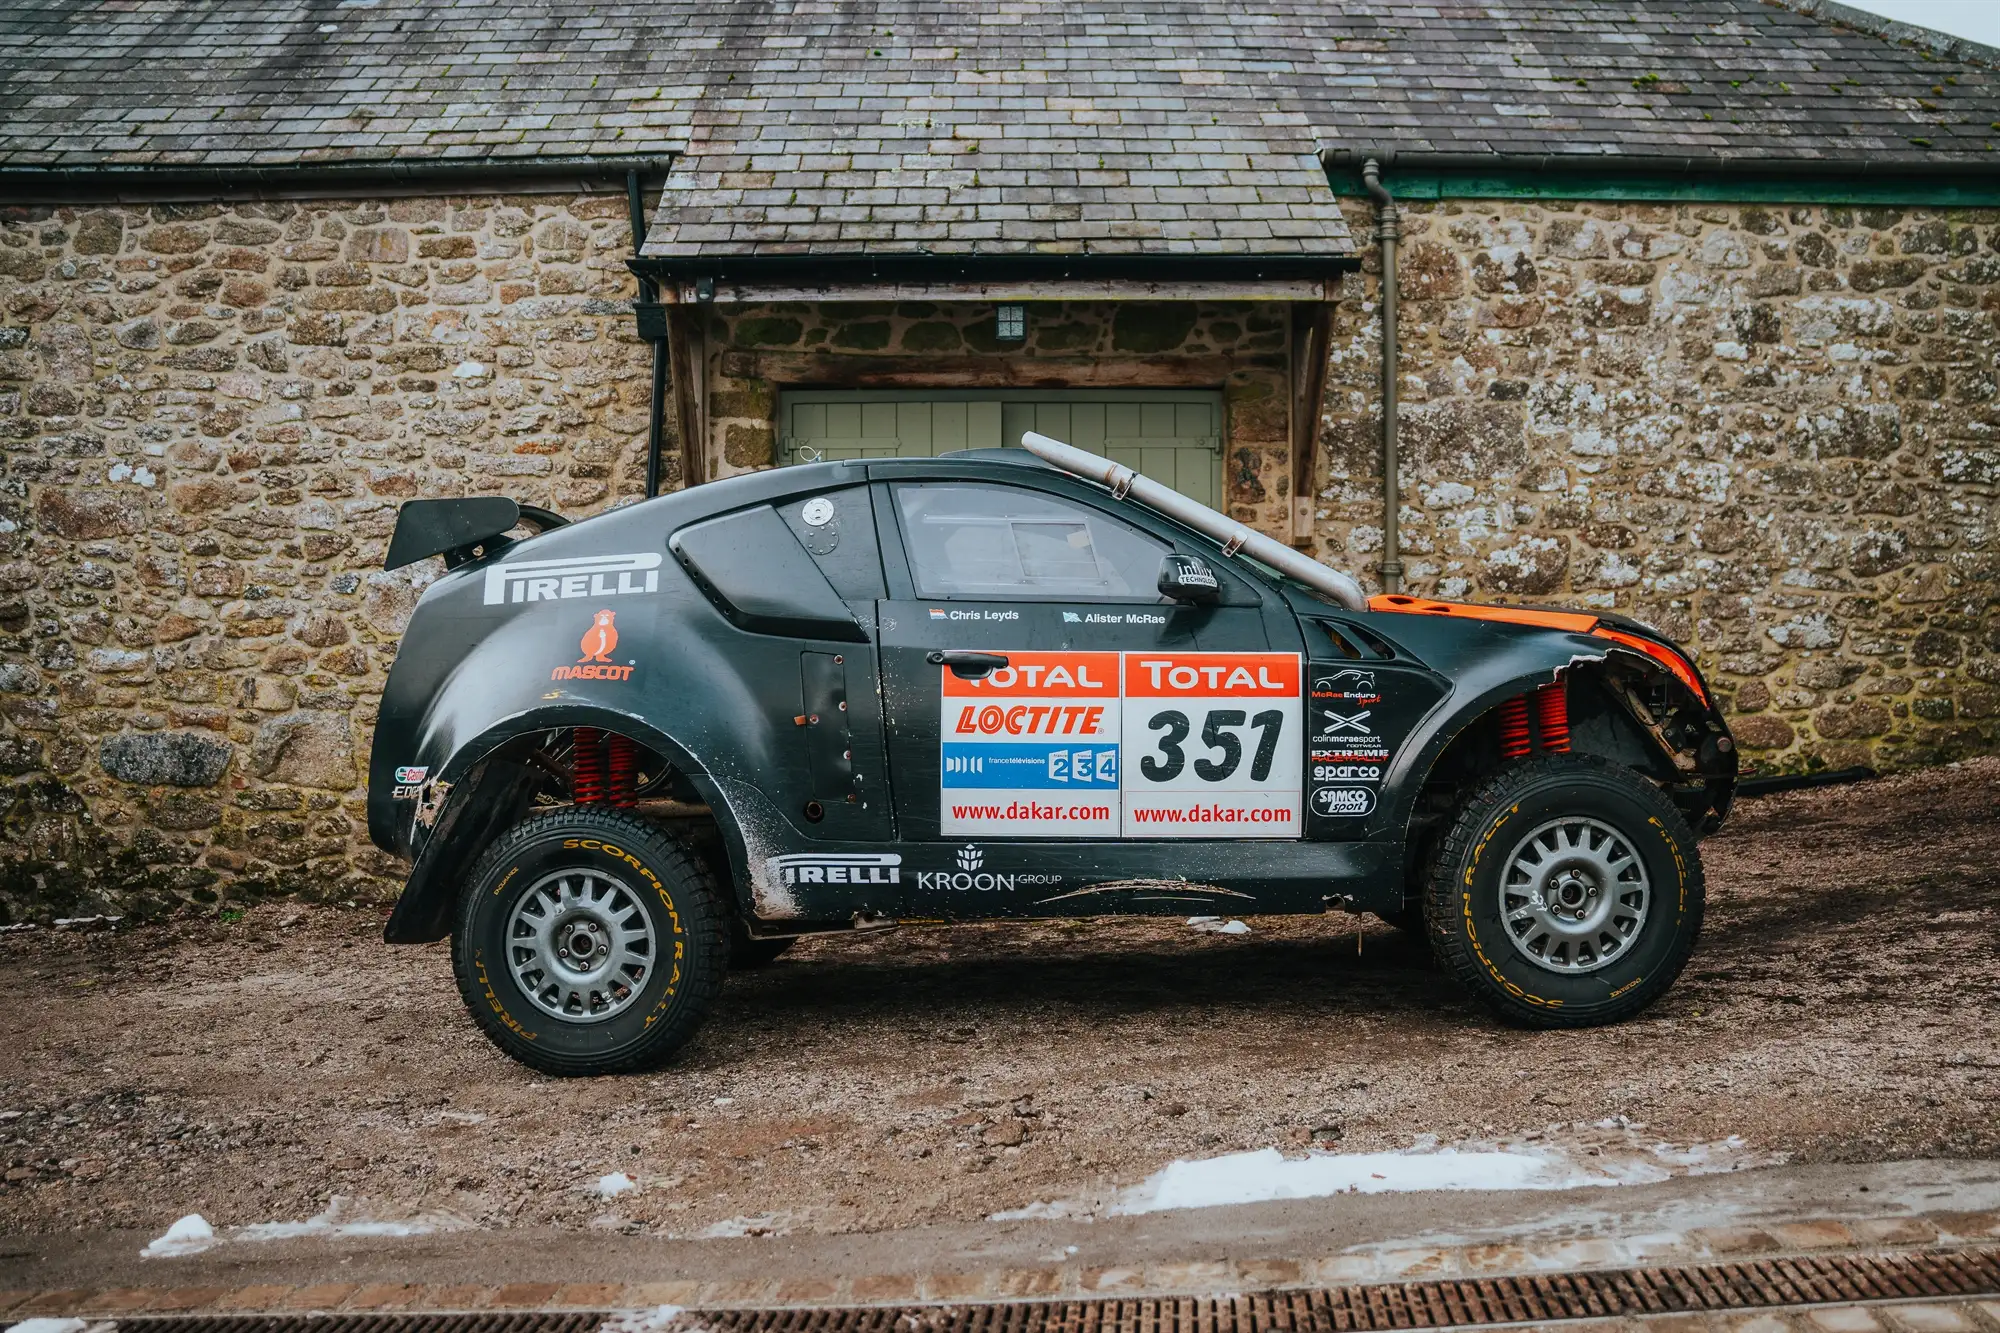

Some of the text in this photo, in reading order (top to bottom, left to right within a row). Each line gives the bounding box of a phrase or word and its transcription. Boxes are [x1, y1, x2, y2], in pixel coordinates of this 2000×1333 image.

[484, 553, 663, 605] PIRELLI
[1177, 561, 1212, 578] influx
[949, 610, 1019, 622] Chris Leyds
[1085, 613, 1166, 624] Alister McRae
[551, 665, 634, 681] MASCOT
[1140, 661, 1284, 690] TOTAL
[955, 706, 1104, 735] LOCTITE
[1140, 709, 1284, 782] 351
[1311, 749, 1389, 757] EXTREME
[1053, 758, 1069, 777] 2
[1077, 758, 1092, 777] 3
[1100, 758, 1116, 778] 4
[1313, 765, 1380, 782] sparco
[1319, 790, 1367, 803] SAMCO
[952, 801, 1110, 820] www.dakar.com
[1134, 804, 1292, 822] www.dakar.com
[1332, 802, 1363, 812] sport
[917, 872, 1062, 891] KROON GROUP
[563, 839, 684, 1029] SCORPION RALLY
[1463, 892, 1564, 1009] SCORPION
[475, 960, 538, 1041] PIRELLI
